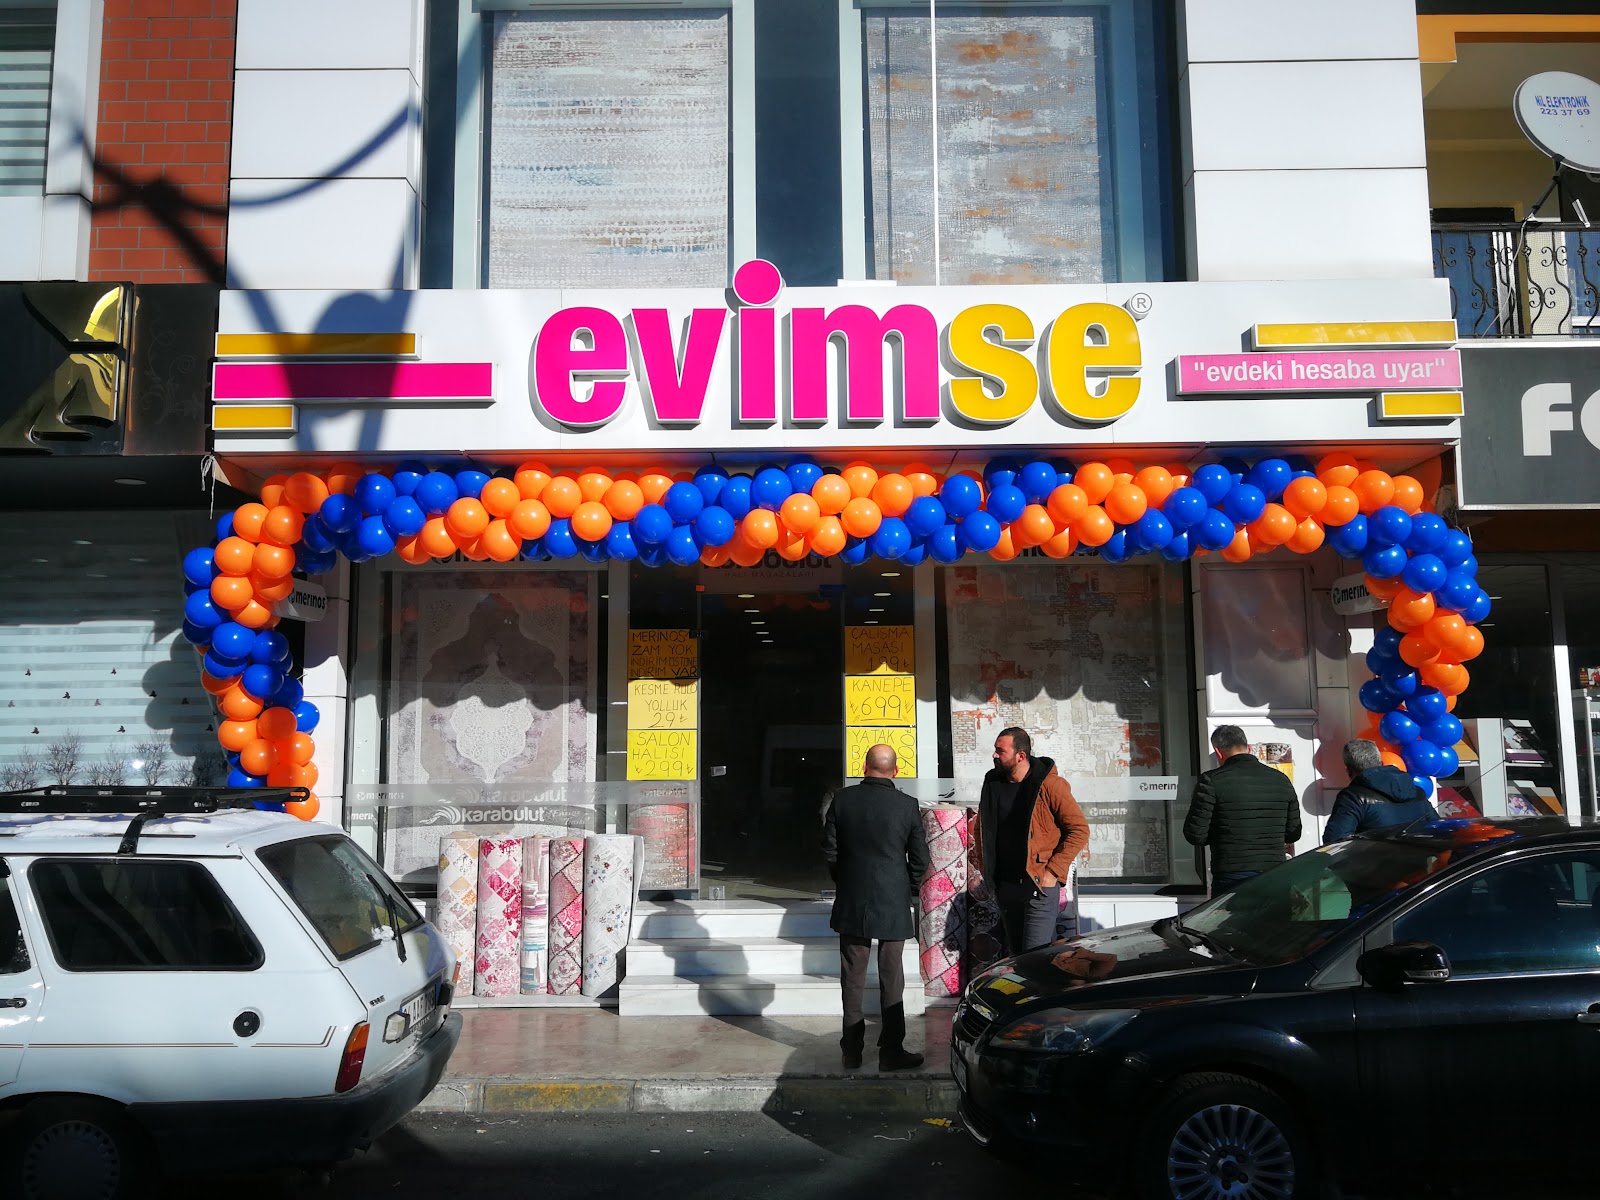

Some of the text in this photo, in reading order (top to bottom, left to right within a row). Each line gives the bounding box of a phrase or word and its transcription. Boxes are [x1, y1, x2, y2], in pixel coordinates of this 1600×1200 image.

[1540, 107, 1558, 116] 223
[1577, 108, 1590, 116] 69
[533, 258, 1143, 427] evimse
[1194, 358, 1446, 383] "evdeki hesaba uyar"
[295, 590, 326, 610] merinos
[631, 643, 693, 656] ZAM YOK
[852, 640, 904, 655] MASASI
[671, 665, 698, 677] VAR
[634, 683, 669, 696] KESME
[852, 676, 912, 692] KANEPE
[645, 699, 688, 712] YOLLUK
[636, 731, 691, 747] SALON
[852, 729, 895, 744] YATAK
[632, 746, 685, 760] HALISI
[1149, 782, 1178, 791] merin
[461, 806, 546, 823] karabulut
